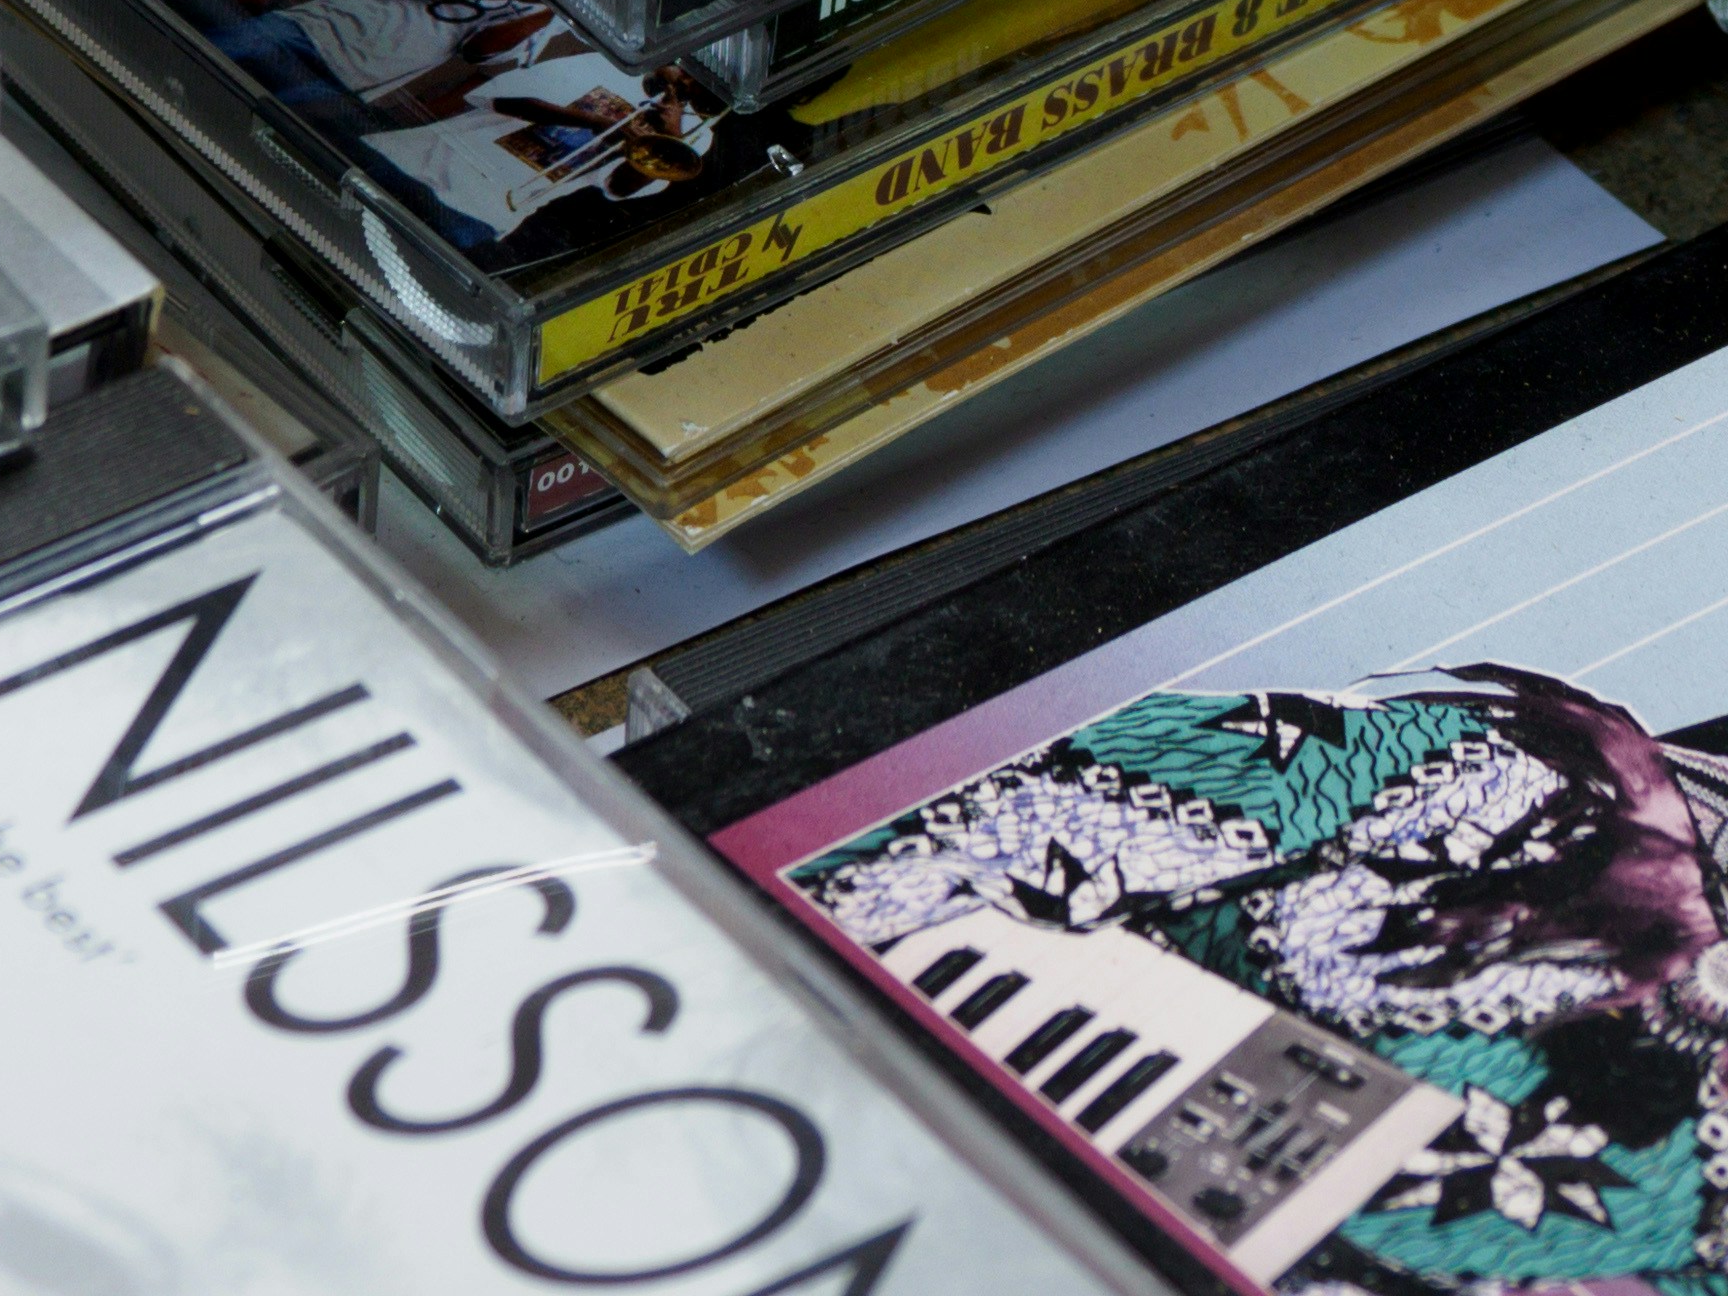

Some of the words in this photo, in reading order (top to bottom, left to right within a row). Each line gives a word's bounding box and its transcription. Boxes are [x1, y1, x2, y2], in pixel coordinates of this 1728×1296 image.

[1040, 13, 1218, 130] BRASS
[876, 105, 1025, 207] BAND
[608, 265, 751, 343] TRU
[614, 232, 755, 311] CD141
